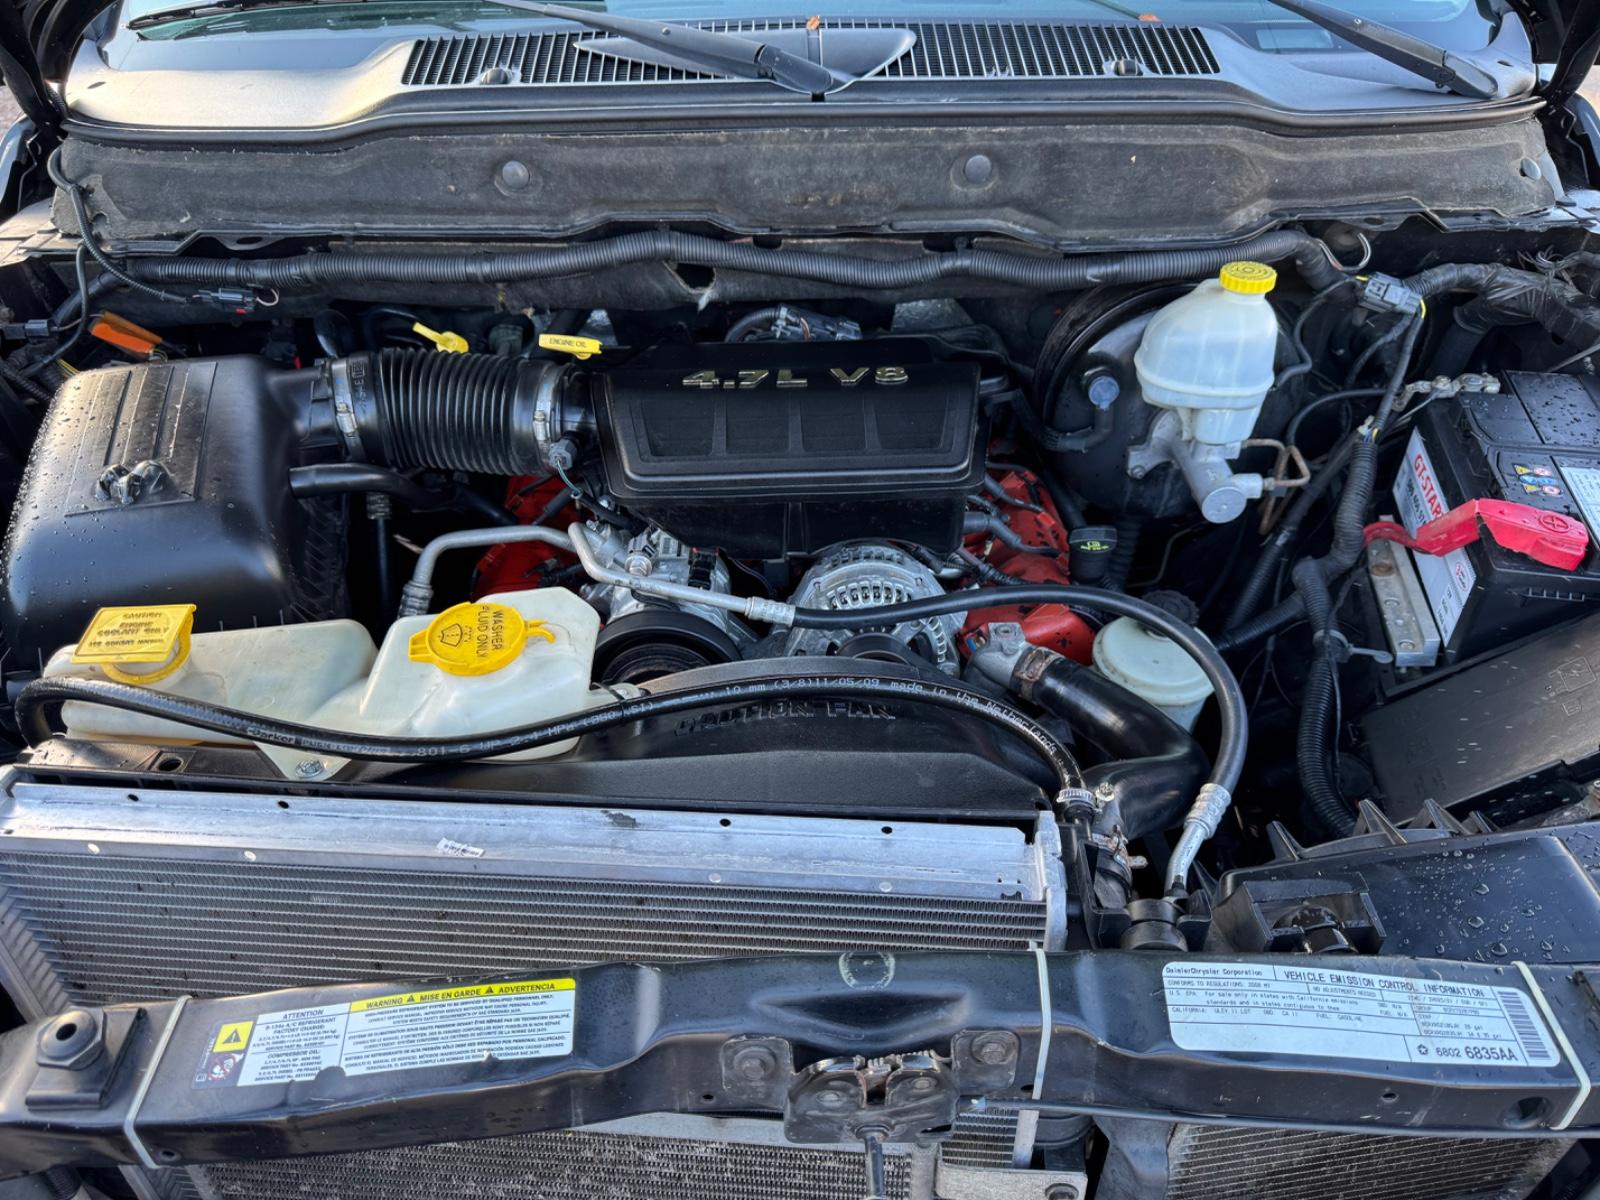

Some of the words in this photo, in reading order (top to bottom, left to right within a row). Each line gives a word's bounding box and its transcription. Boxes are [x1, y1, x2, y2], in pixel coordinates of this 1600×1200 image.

[682, 368, 808, 389] 4.7L
[830, 366, 909, 387] V8
[414, 452, 444, 517] GT-STAR
[477, 605, 490, 633] FLUID
[492, 610, 504, 651] WASHER
[476, 634, 489, 659] ONLY
[890, 681, 924, 692] made
[933, 687, 948, 697] in
[985, 700, 1058, 755] Netherlands
[1222, 968, 1263, 977] Corporation
[1284, 970, 1326, 982] VEHICLE
[1329, 973, 1376, 988] EMISSION
[1379, 979, 1418, 992] CONTROL
[1423, 983, 1485, 997] INFORMATION
[366, 997, 403, 1009] WARNING
[419, 993, 440, 1002] MISE
[441, 991, 453, 999] EN
[454, 988, 481, 998] GARDE
[499, 982, 555, 994] ADVERTENCIA
[283, 1009, 324, 1020] ATTENTION
[1435, 1046, 1462, 1058] 6802
[1464, 1045, 1519, 1062] 6835AA
